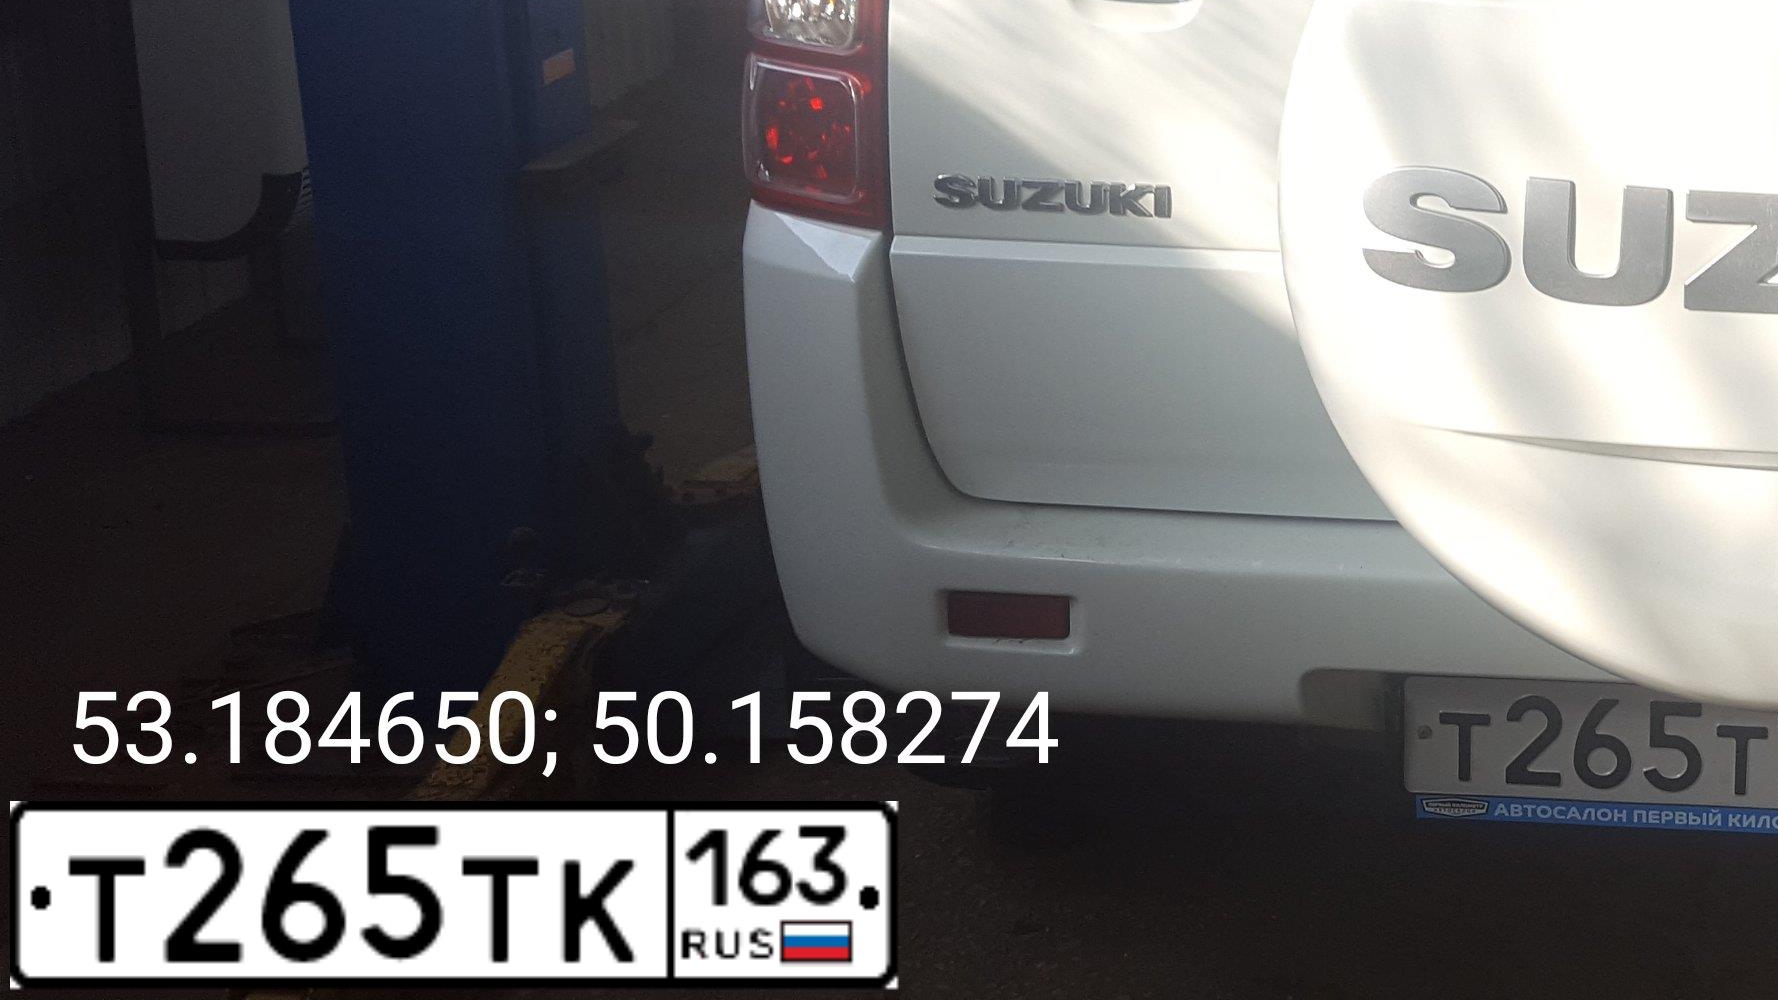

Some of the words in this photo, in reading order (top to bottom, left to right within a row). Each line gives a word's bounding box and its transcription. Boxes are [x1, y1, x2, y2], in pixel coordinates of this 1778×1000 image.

[932, 173, 1173, 219] SUZUKI
[1494, 803, 1627, 823] АВТОСАЛОН
[1633, 808, 1722, 827] ПЕРВЫЙ
